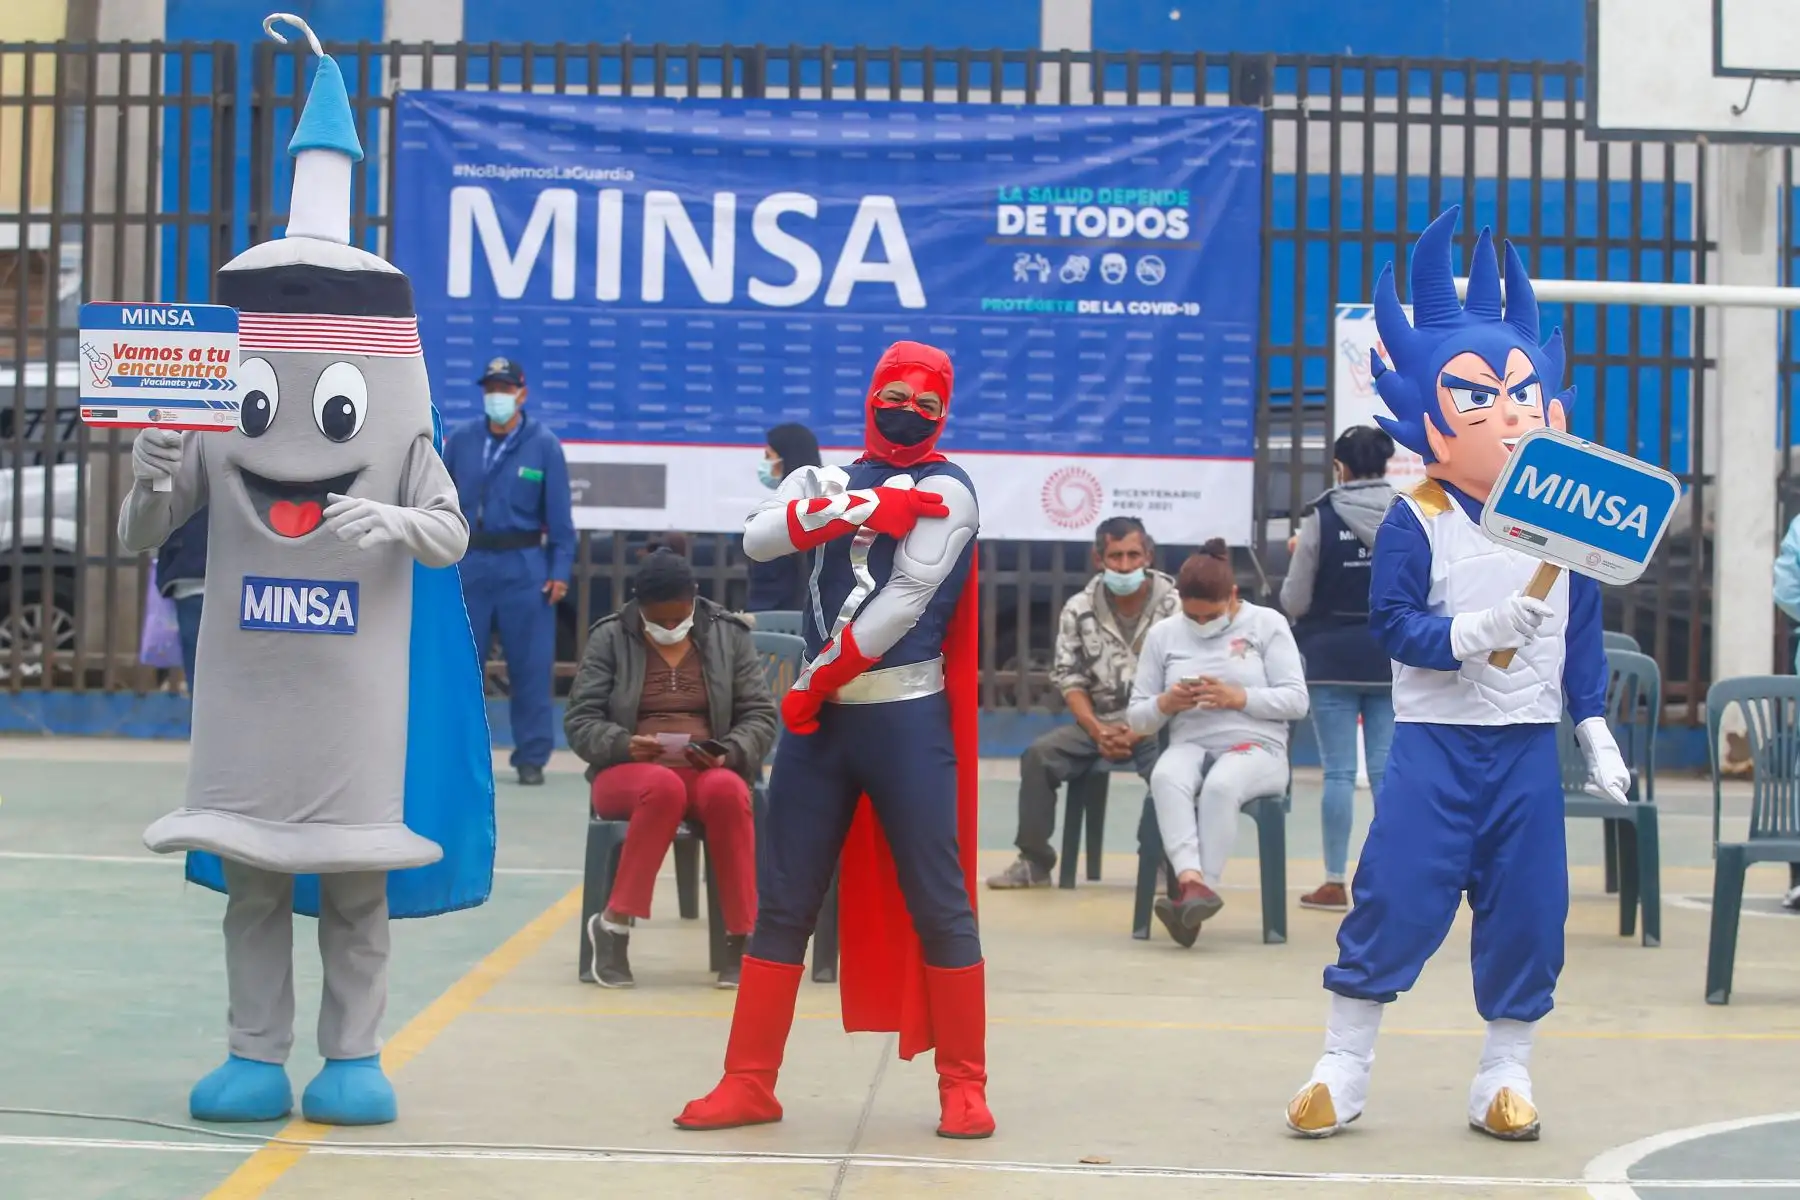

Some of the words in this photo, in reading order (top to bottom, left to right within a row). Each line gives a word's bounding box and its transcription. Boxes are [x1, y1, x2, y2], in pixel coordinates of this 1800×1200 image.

[453, 164, 635, 182] #NoBajemosLaGuardia
[998, 187, 1023, 202] LA
[1028, 187, 1093, 205] SALUD
[1098, 188, 1190, 207] DEPENDE
[997, 204, 1047, 236] DE
[1054, 206, 1190, 240] TODOS
[446, 186, 926, 310] MINSA
[122, 308, 194, 325] MINSA
[1077, 300, 1100, 314] DE
[1103, 301, 1125, 315] LA
[1127, 301, 1200, 316] COVID-19
[113, 343, 182, 361] Vamos
[189, 349, 202, 361] a
[207, 347, 230, 362] tu
[118, 362, 227, 378] encuentro
[140, 377, 185, 387] ¡Vacúnate
[187, 380, 202, 389] ya!
[1513, 464, 1649, 539] MINSA
[244, 585, 354, 626] MINSA
